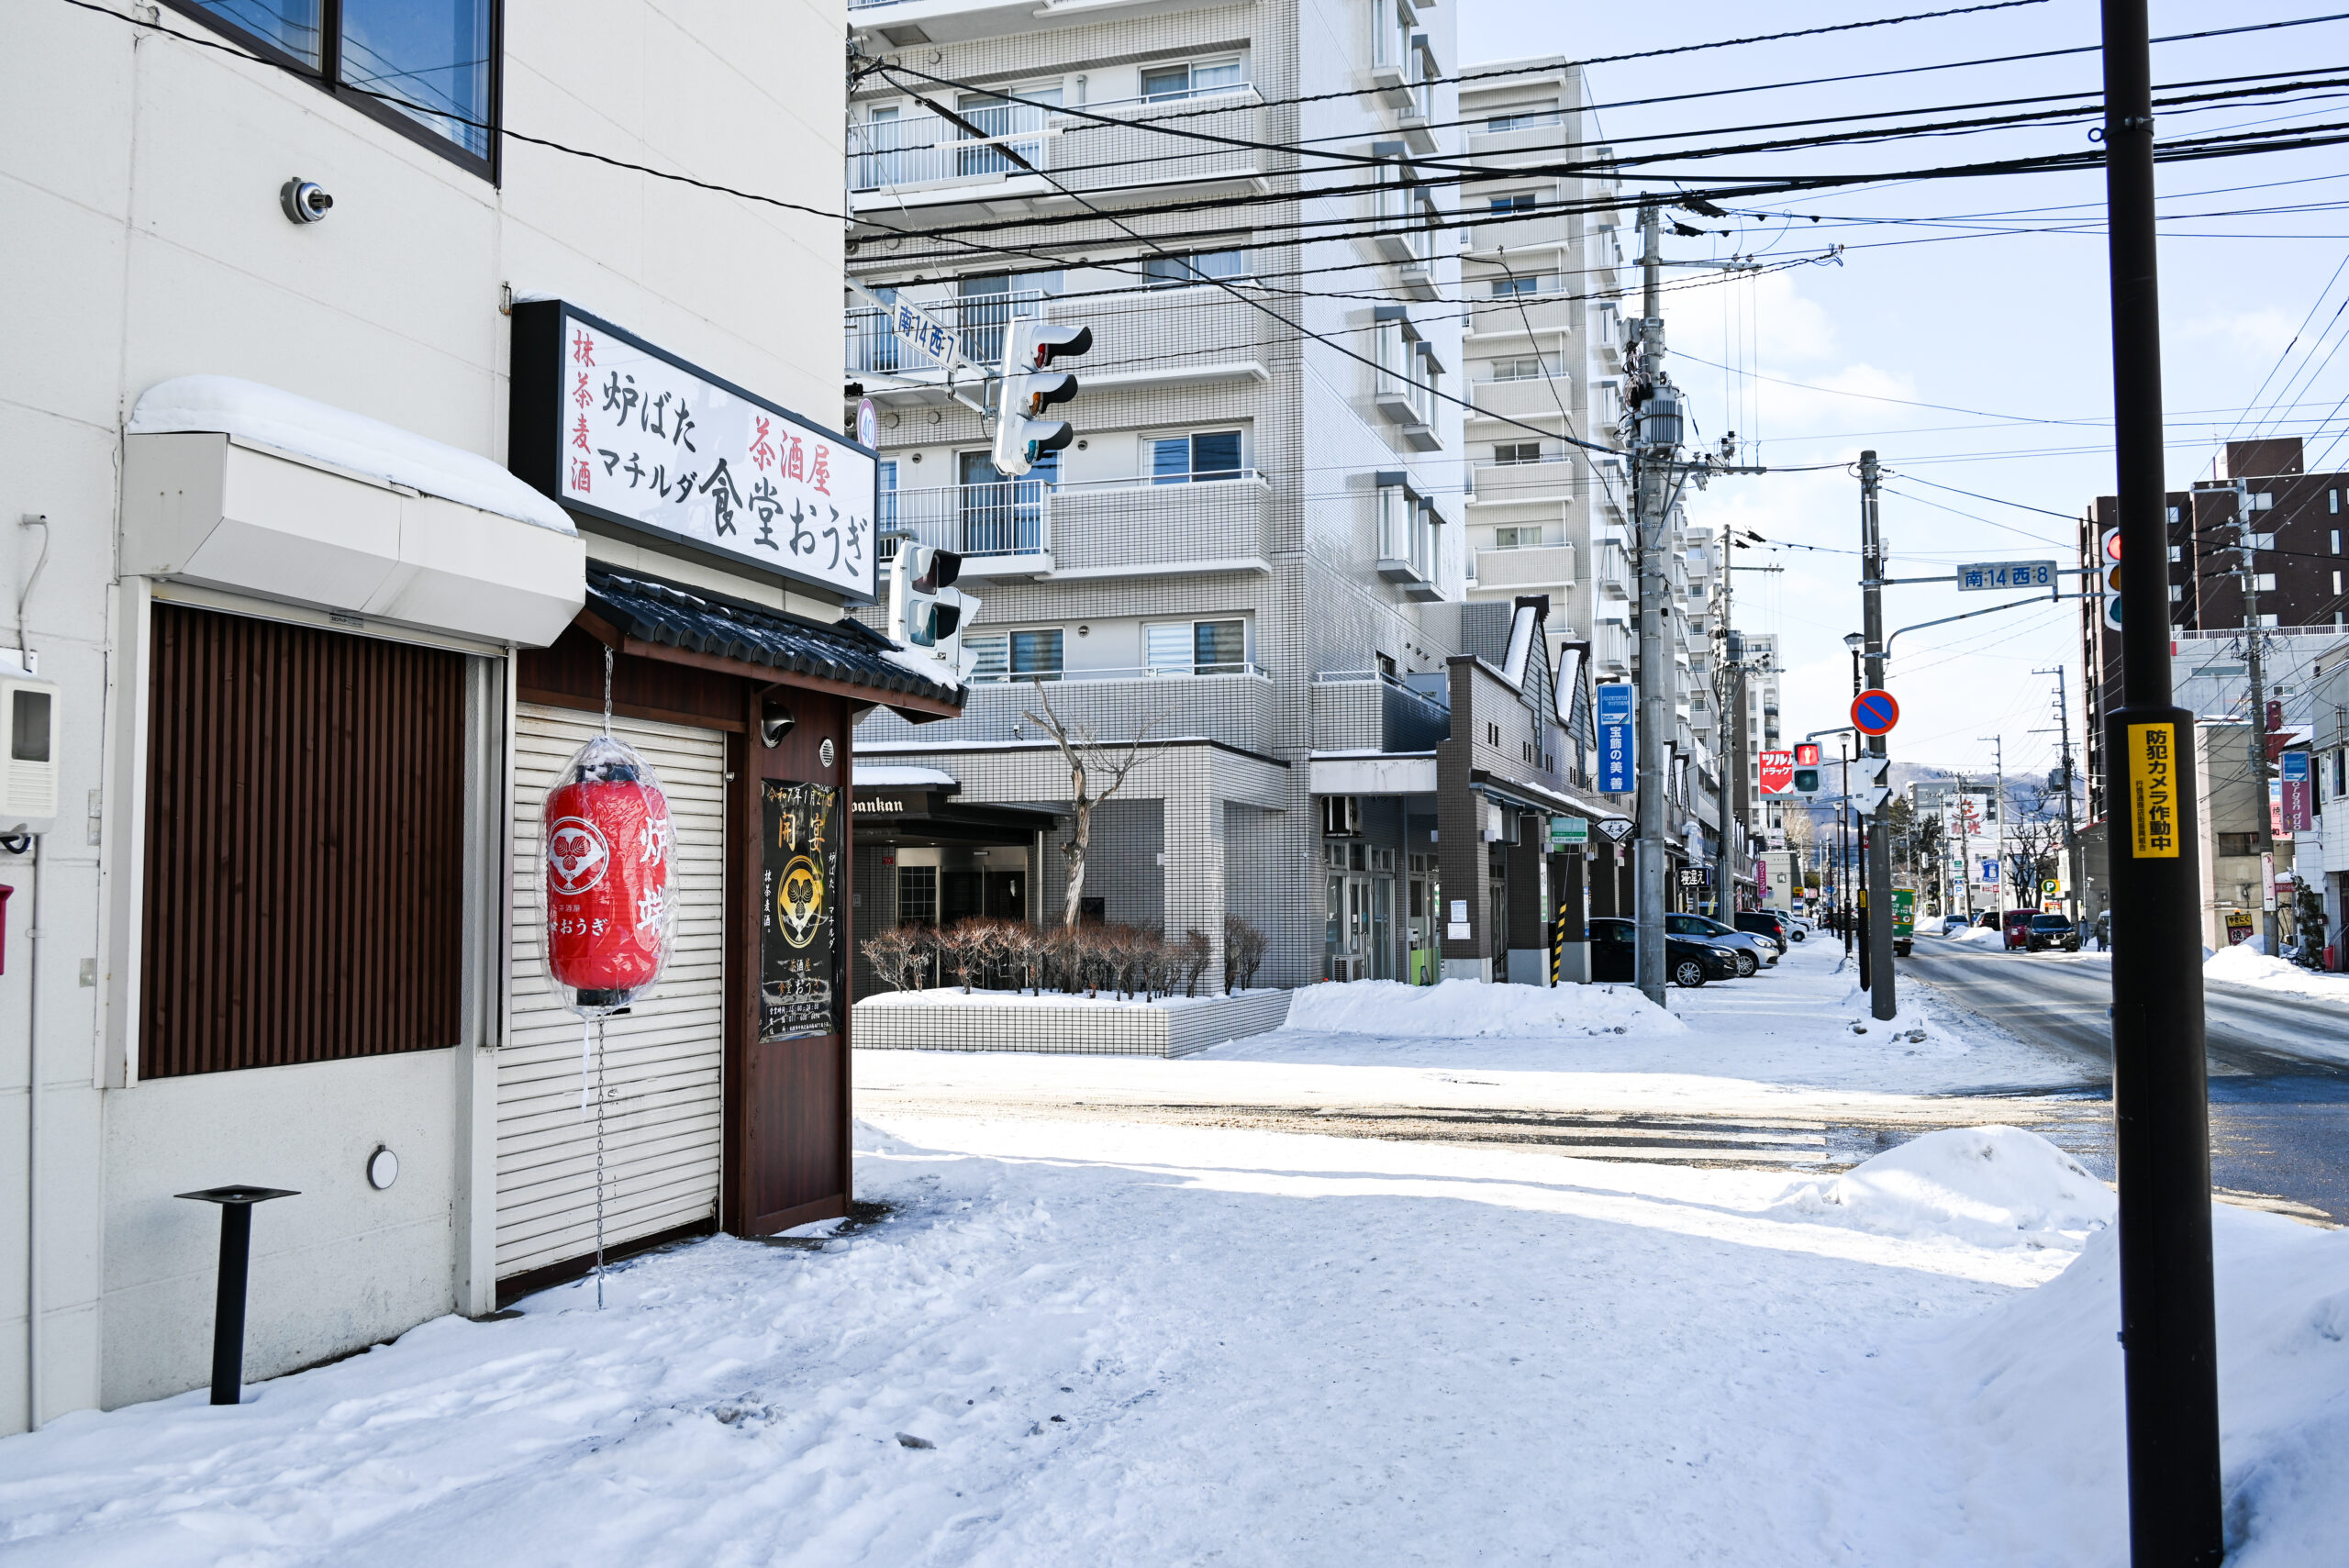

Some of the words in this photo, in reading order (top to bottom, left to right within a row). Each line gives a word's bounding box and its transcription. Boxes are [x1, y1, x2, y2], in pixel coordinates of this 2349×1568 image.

[898, 306, 954, 364] 南14西7
[571, 329, 596, 494] 抹茶麦酒
[602, 371, 697, 452] 炉ばた
[862, 417, 874, 444] 40
[597, 448, 698, 504] マチルダ
[749, 416, 830, 496] 茶酒屋
[699, 459, 868, 577] 食堂おうぎ
[1965, 566, 2048, 588] 南14西8
[1609, 726, 1623, 790] 宝飾の美善
[2145, 729, 2172, 851] 防犯カメラ作動中
[2045, 882, 2054, 892] P
